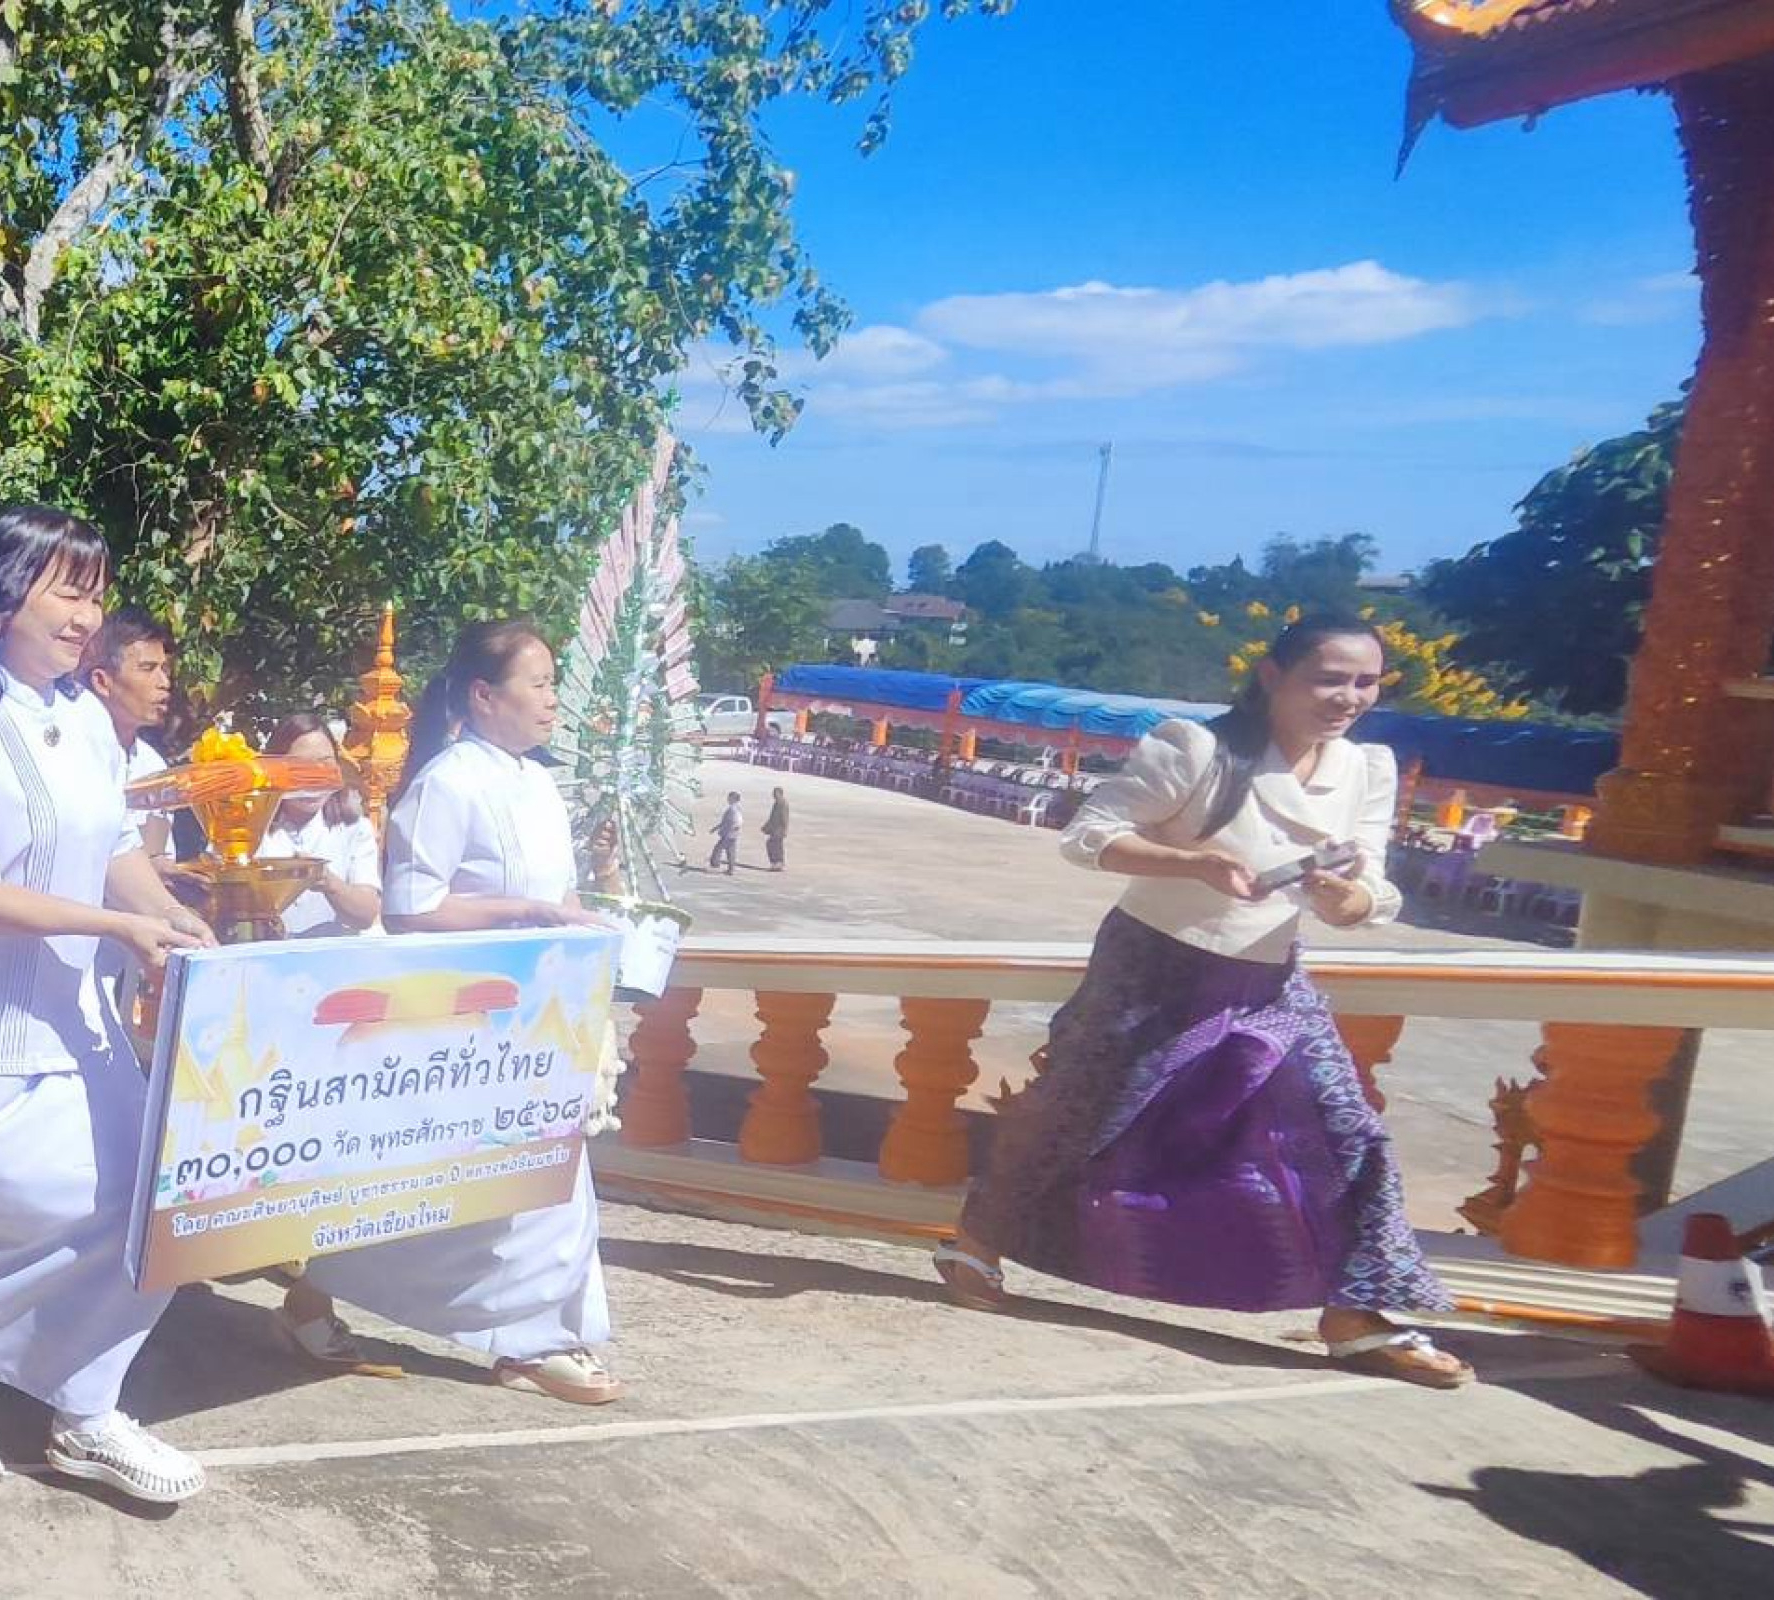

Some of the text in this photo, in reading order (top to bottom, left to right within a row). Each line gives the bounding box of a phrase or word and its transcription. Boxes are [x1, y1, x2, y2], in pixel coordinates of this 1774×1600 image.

[239, 1033, 554, 1128] กฐินสามัคคีทั่วไทย
[176, 1095, 583, 1186] ๓๐,๐๐๐ วัด พุทธศักราช ๒๕๖๘
[174, 1213, 208, 1236] โดย
